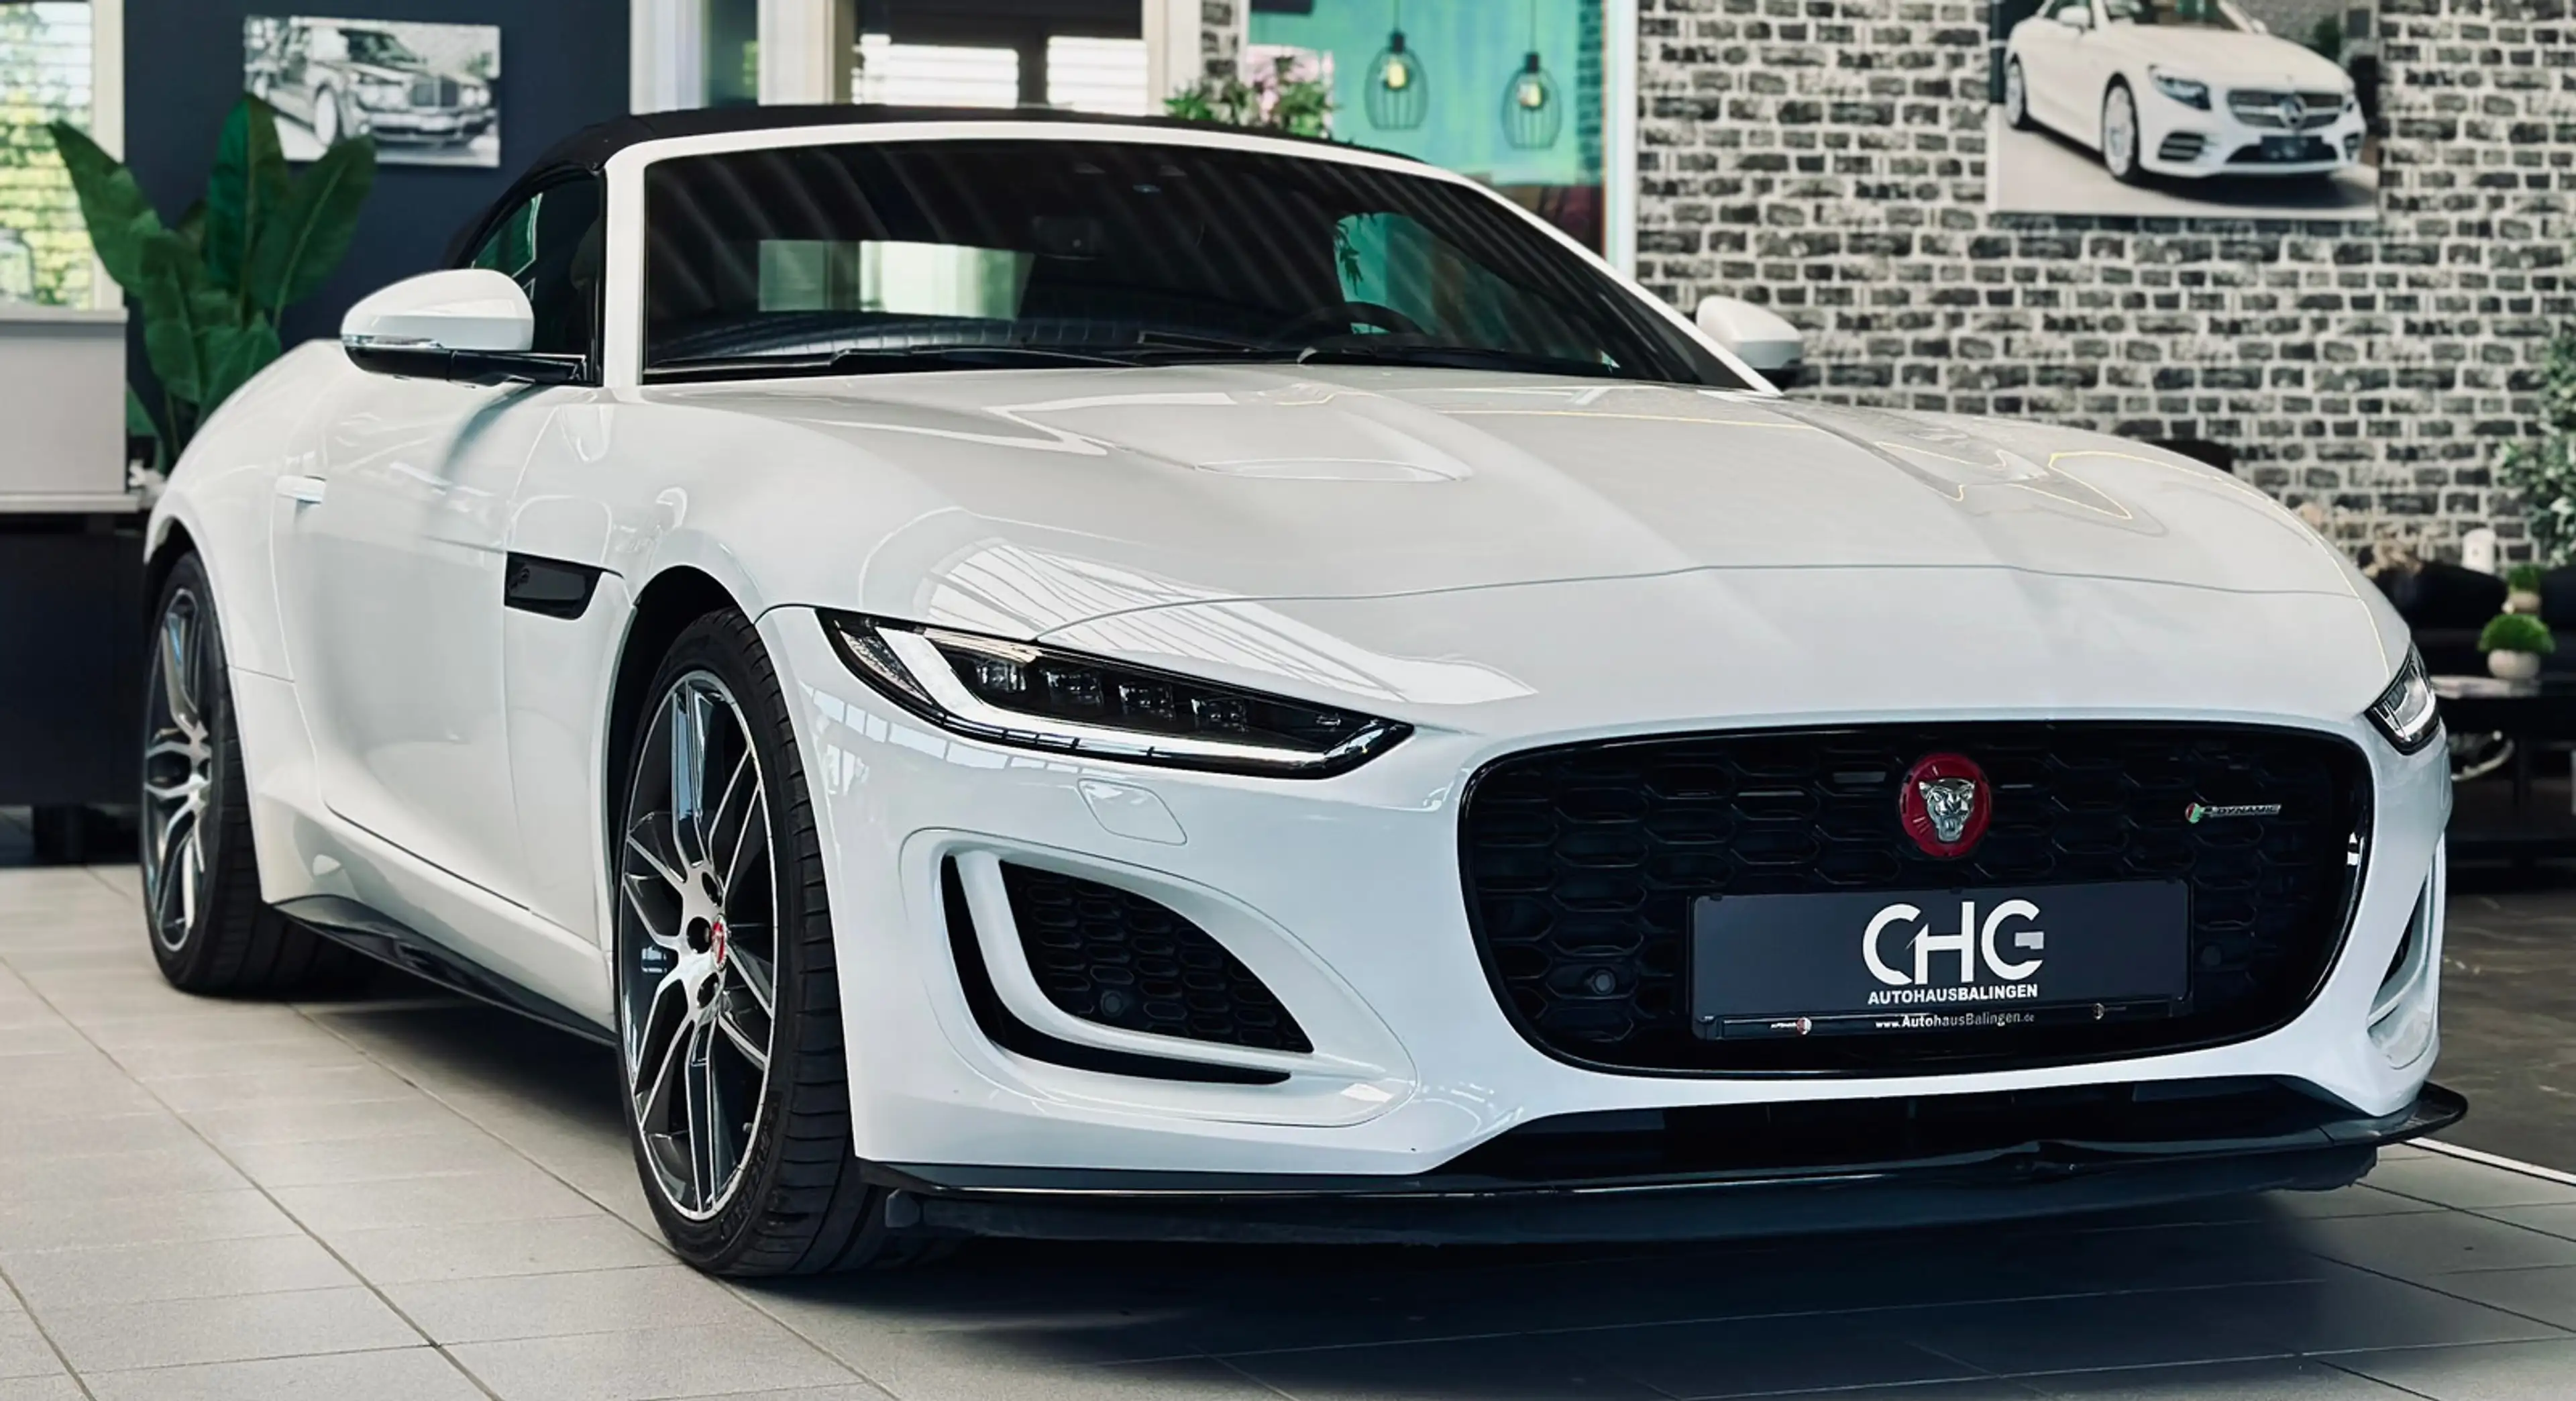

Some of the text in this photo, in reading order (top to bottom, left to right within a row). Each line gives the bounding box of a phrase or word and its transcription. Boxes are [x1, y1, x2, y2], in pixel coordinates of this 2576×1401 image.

[1863, 899, 2044, 984] CHG
[1868, 984, 2038, 1004] AUTOHAUSBALINGEN
[1875, 1012, 2035, 1027] www.AutohausBalingen.de
